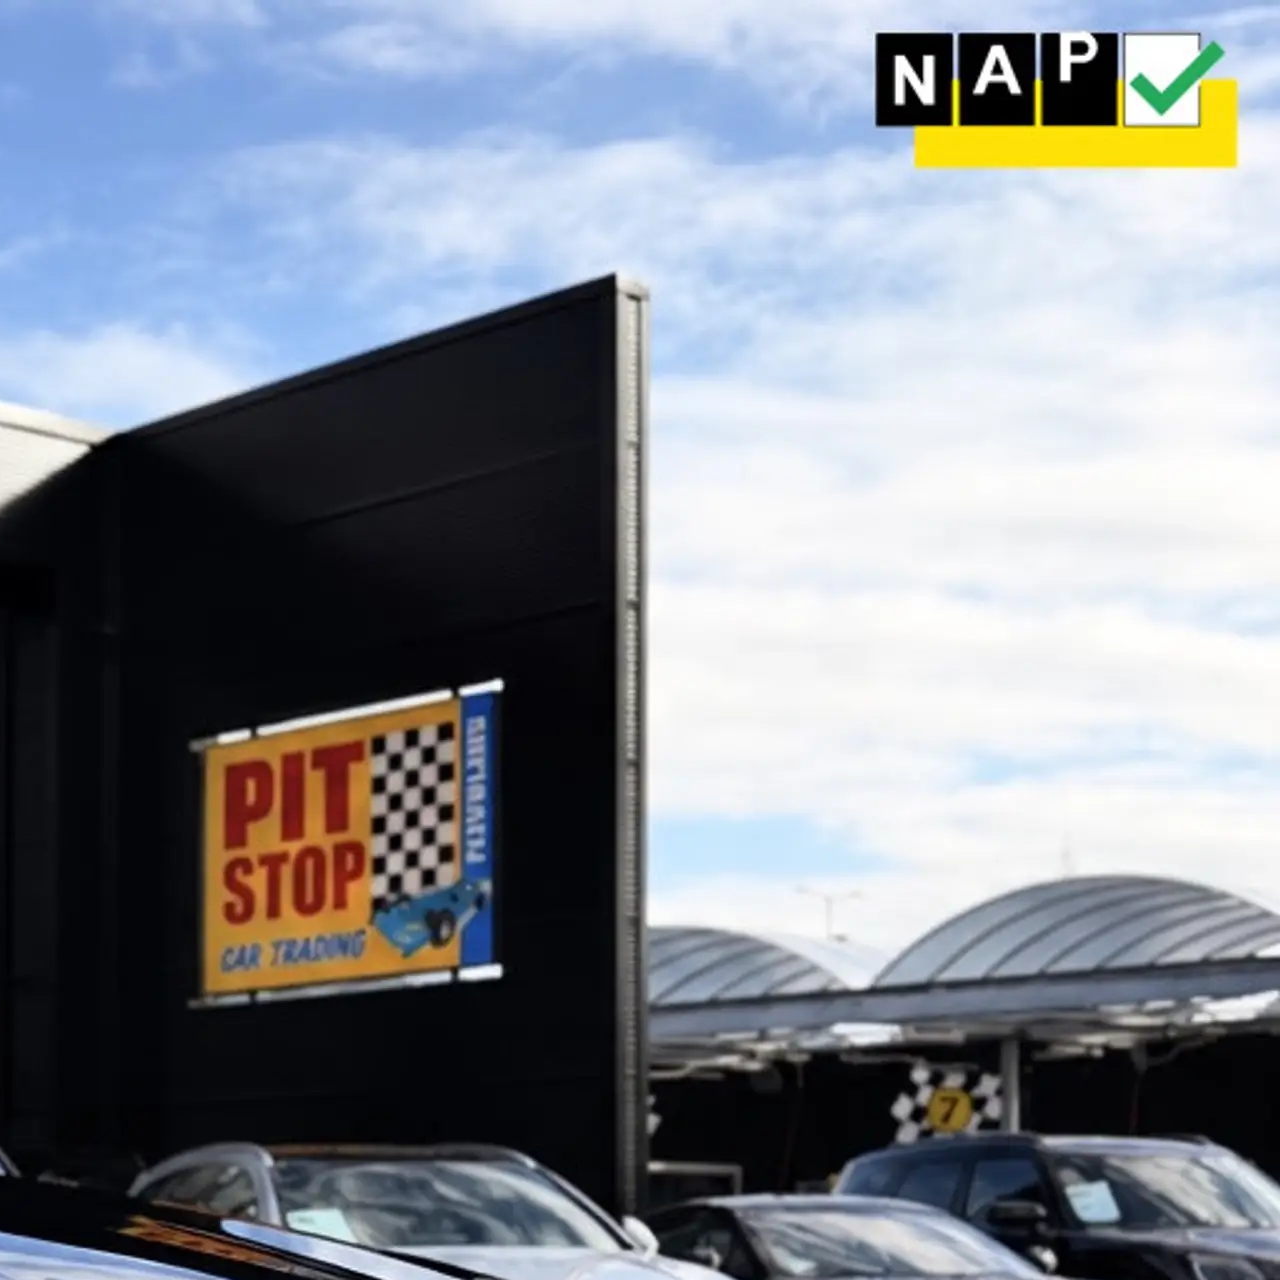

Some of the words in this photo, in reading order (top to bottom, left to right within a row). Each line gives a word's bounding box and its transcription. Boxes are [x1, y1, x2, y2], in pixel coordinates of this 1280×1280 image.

[224, 738, 366, 850] PIT
[222, 840, 366, 926] STOP
[220, 942, 263, 974] CAR
[270, 929, 367, 968] TRADING
[941, 1096, 959, 1124] 7
